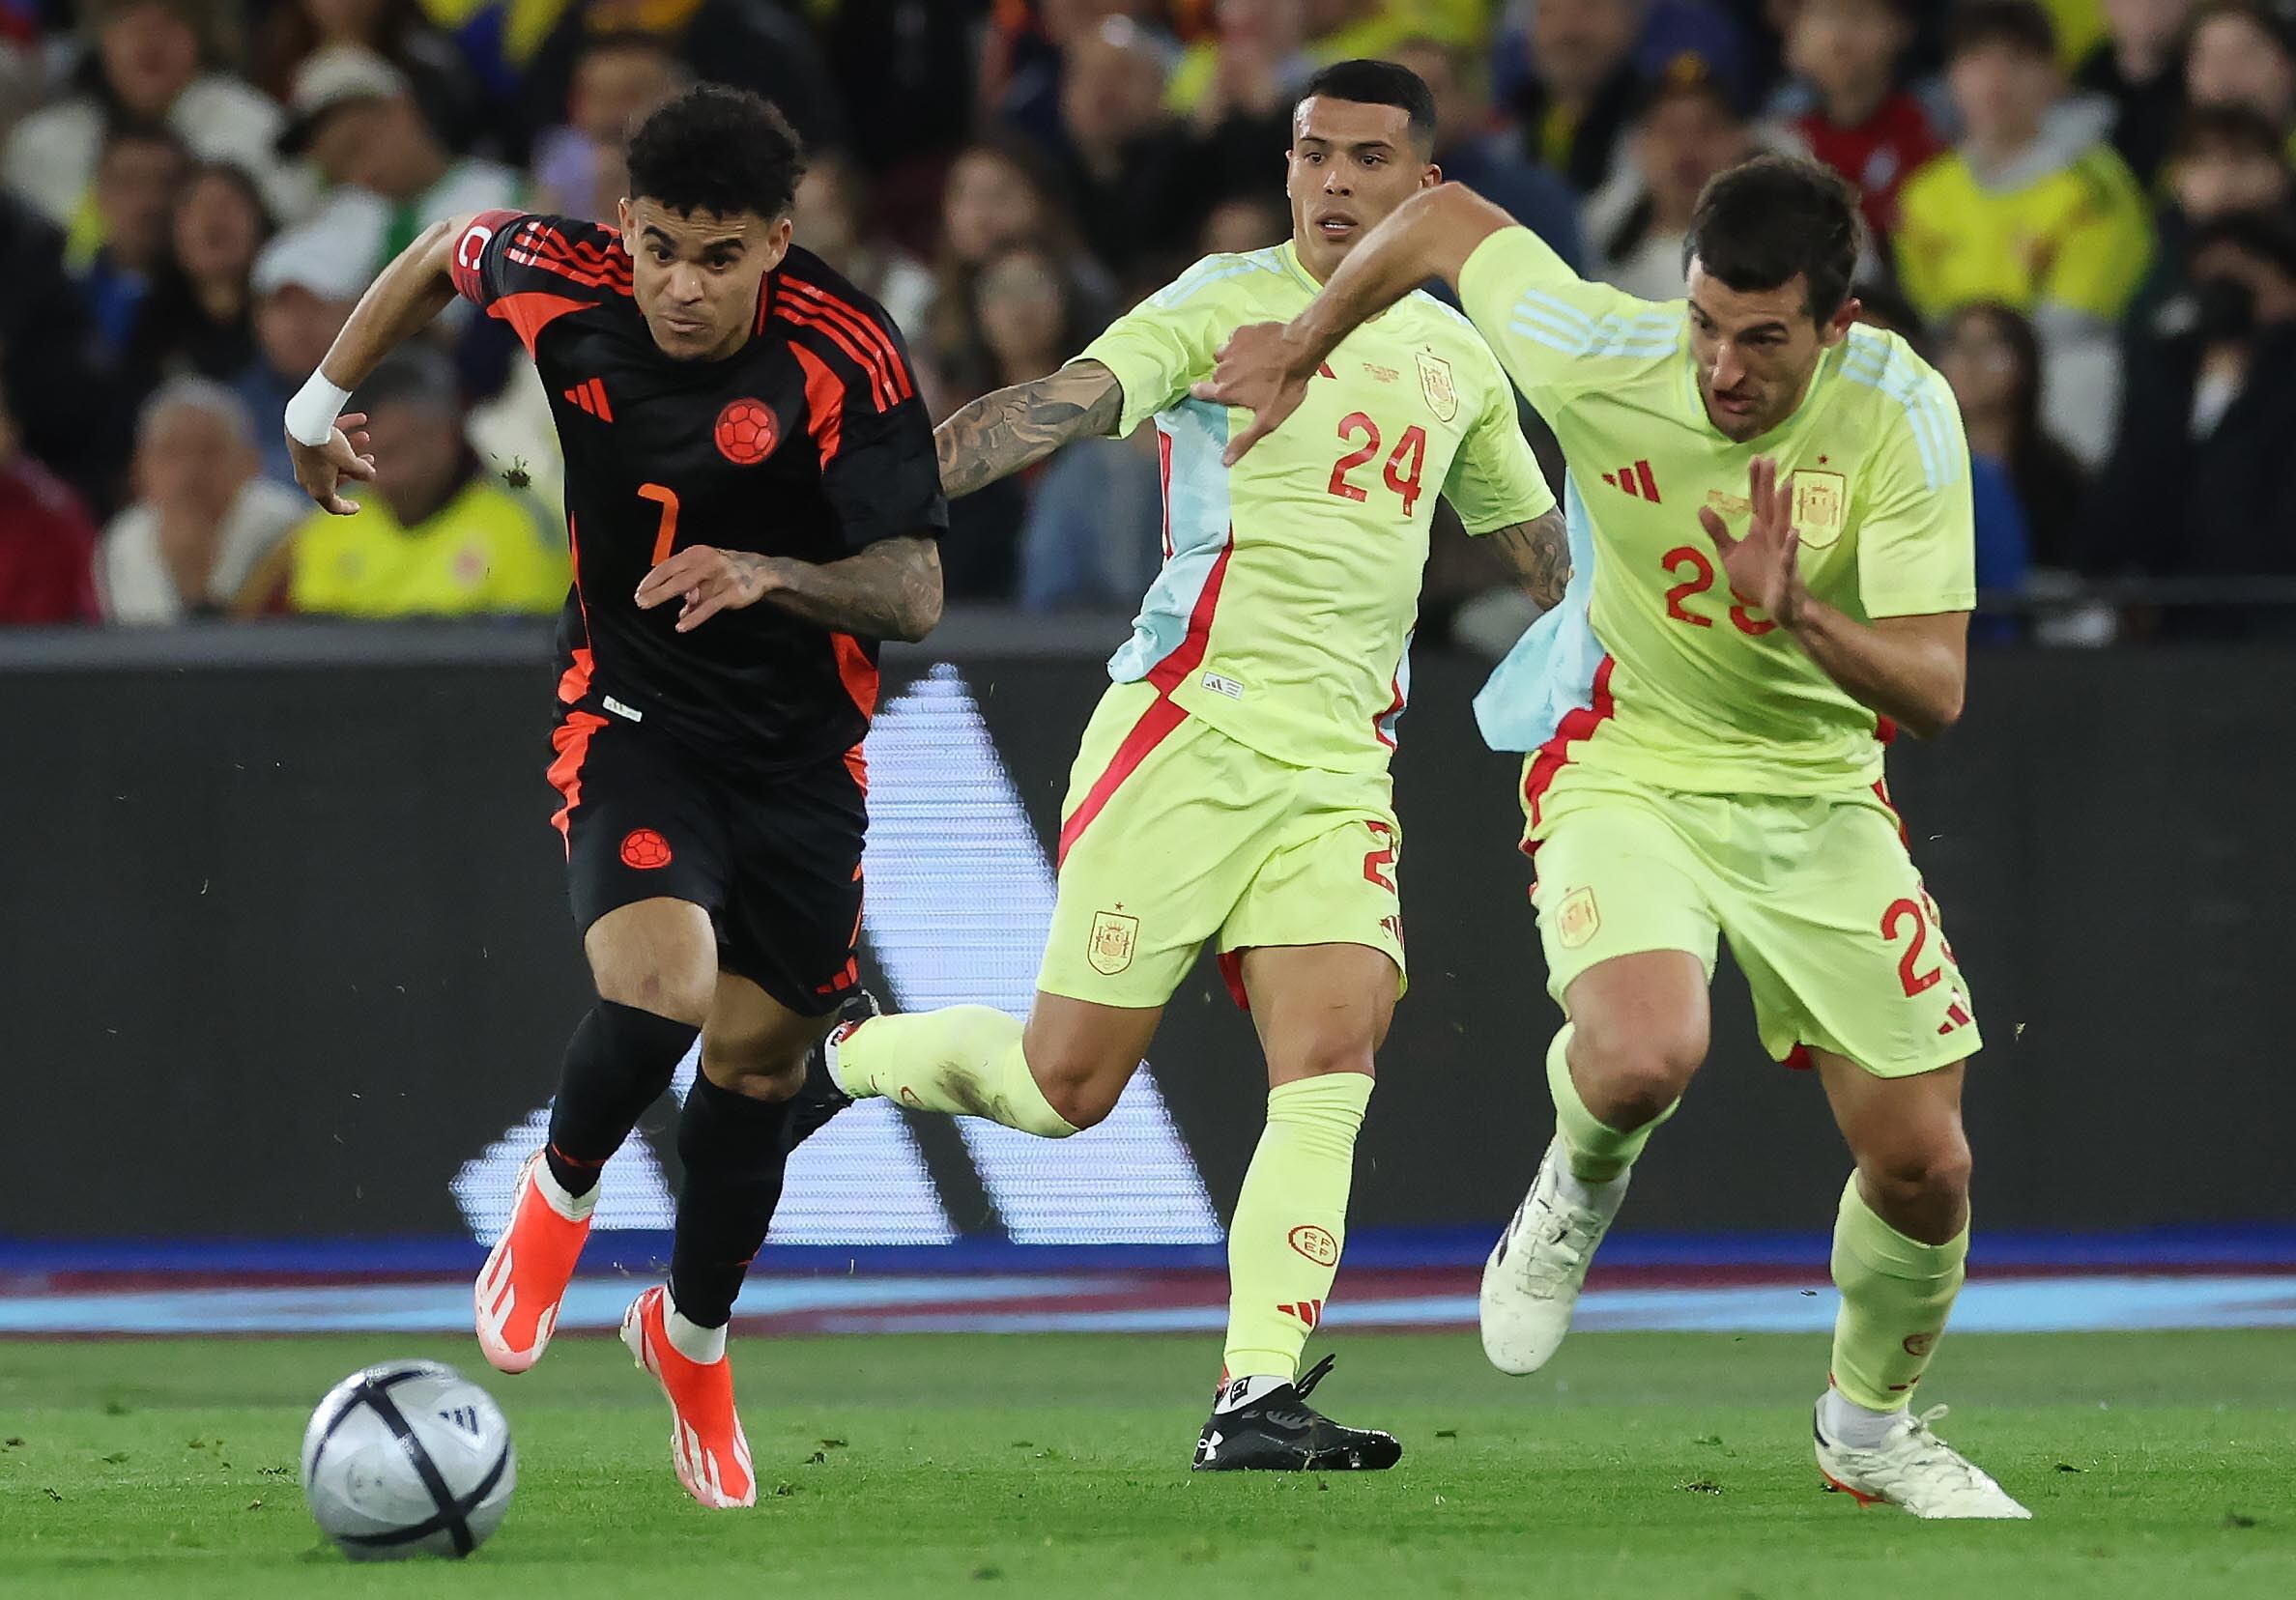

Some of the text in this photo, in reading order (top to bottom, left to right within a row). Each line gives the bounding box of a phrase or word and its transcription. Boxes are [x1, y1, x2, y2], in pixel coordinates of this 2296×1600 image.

[458, 225, 493, 271] C
[1328, 411, 1426, 517] 24
[638, 482, 679, 566] 7
[1880, 880, 1957, 998] 2
